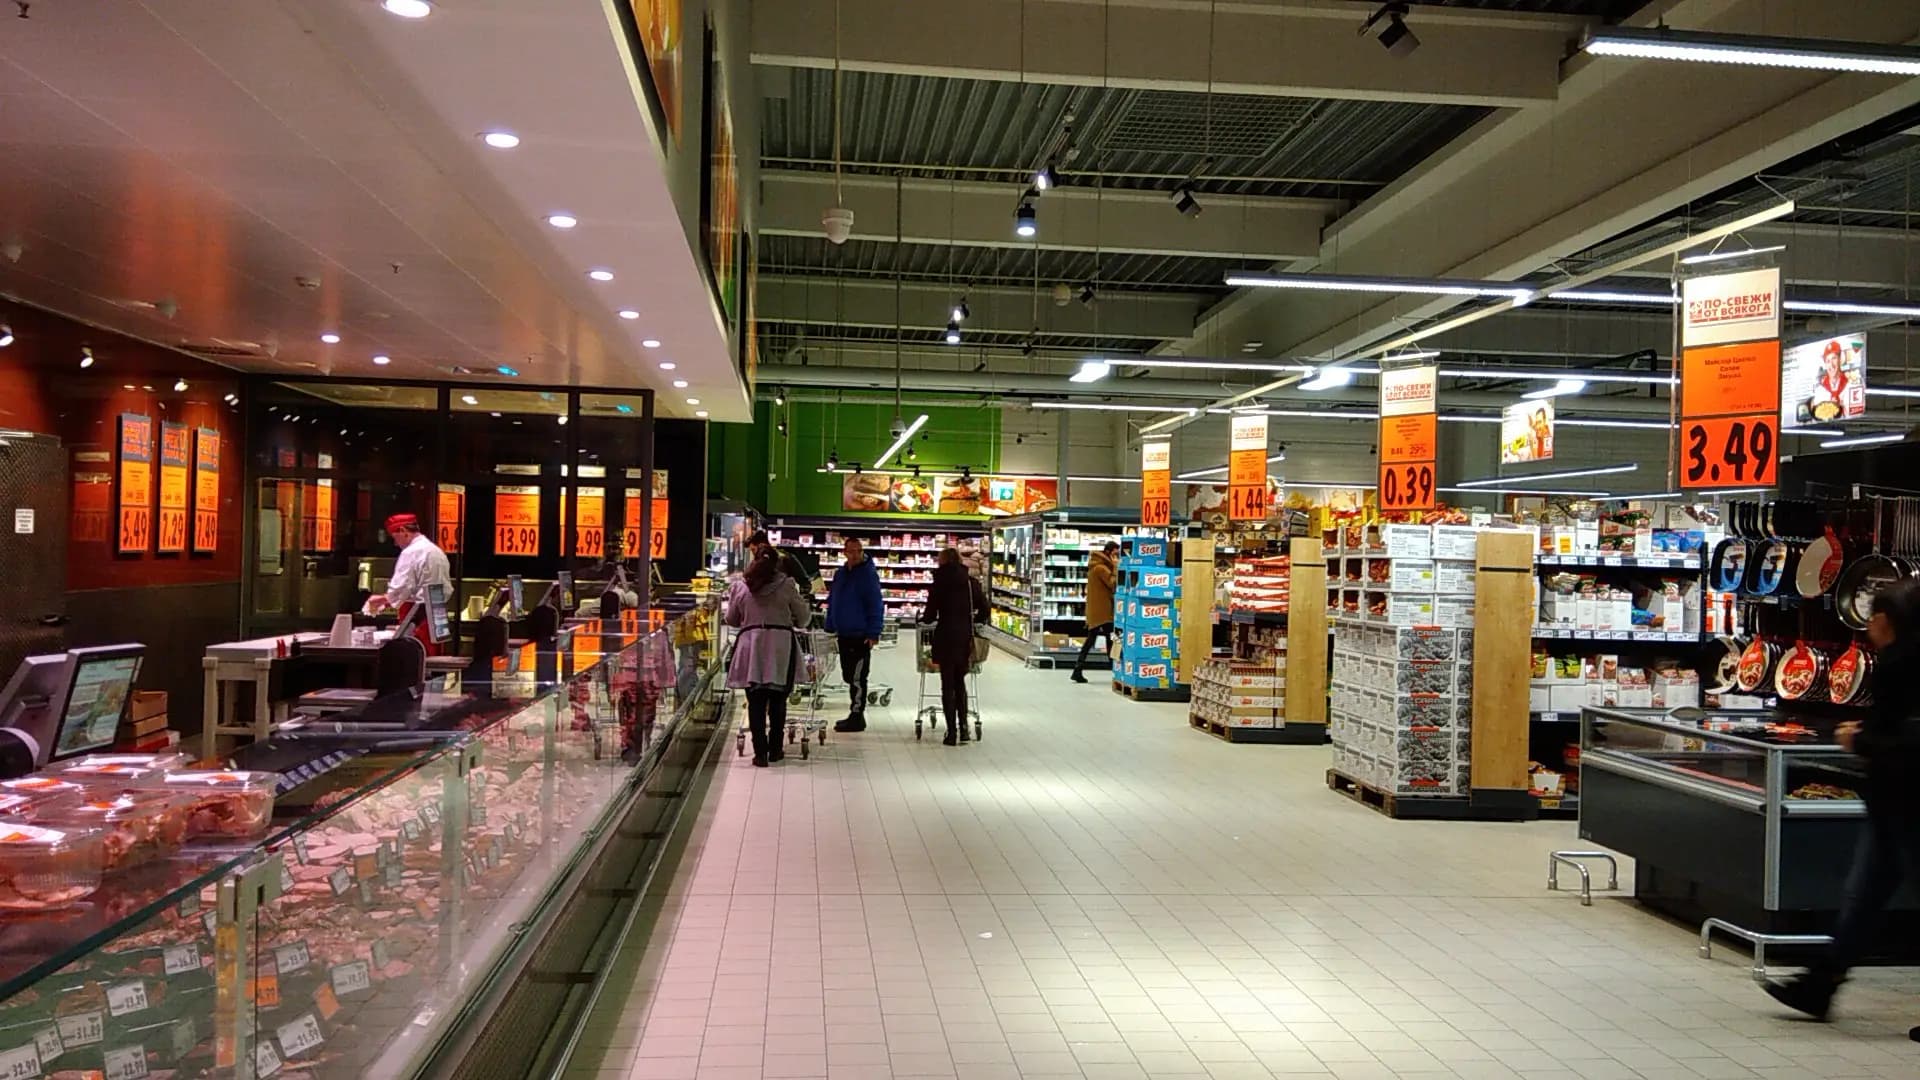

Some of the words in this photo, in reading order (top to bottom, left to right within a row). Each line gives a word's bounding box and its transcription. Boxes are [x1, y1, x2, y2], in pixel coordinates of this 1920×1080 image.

[1704, 292, 1772, 309] ПО-СВЕЖИ
[1704, 309, 1718, 318] ОТ
[1721, 303, 1771, 316] ВСЯКОГА
[1688, 421, 1772, 482] 3.49
[1384, 466, 1432, 506] 0.39
[1233, 488, 1264, 517] 1.44
[1144, 500, 1168, 524] 0.49
[123, 510, 147, 547] 5.49
[499, 527, 536, 553] 13.99
[1140, 545, 1161, 556] Star
[1146, 575, 1167, 586] Star
[1144, 606, 1167, 618] Star
[1143, 636, 1167, 648] Star
[1141, 666, 1165, 677] Star
